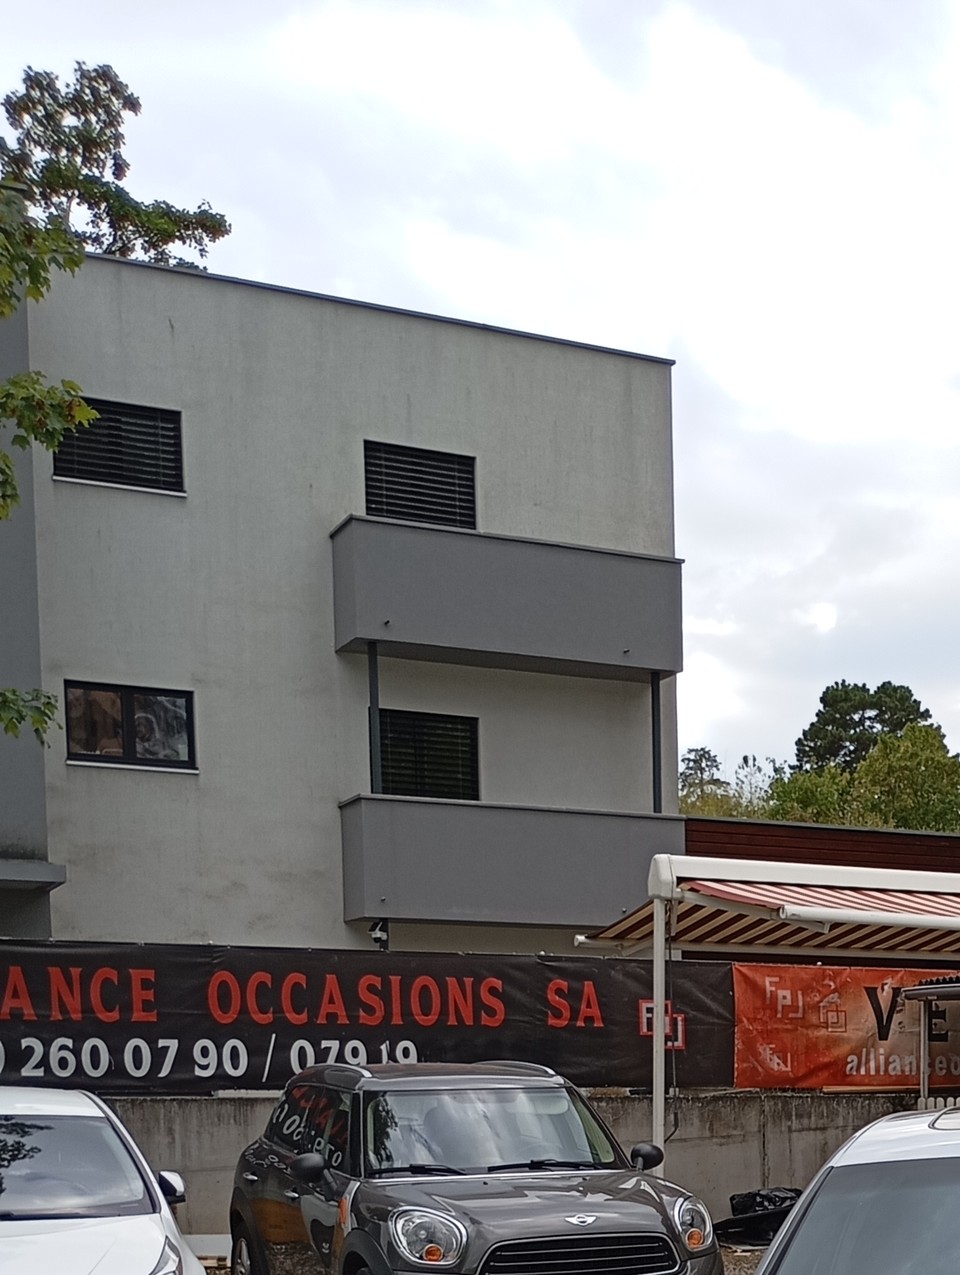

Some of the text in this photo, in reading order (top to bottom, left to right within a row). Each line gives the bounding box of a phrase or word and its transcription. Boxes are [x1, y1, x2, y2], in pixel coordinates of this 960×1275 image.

[0, 966, 605, 1027] ANCE OCCASIONS SA
[20, 1037, 110, 1078] 260
[124, 1037, 179, 1078] 07
[193, 1038, 249, 1078] 90
